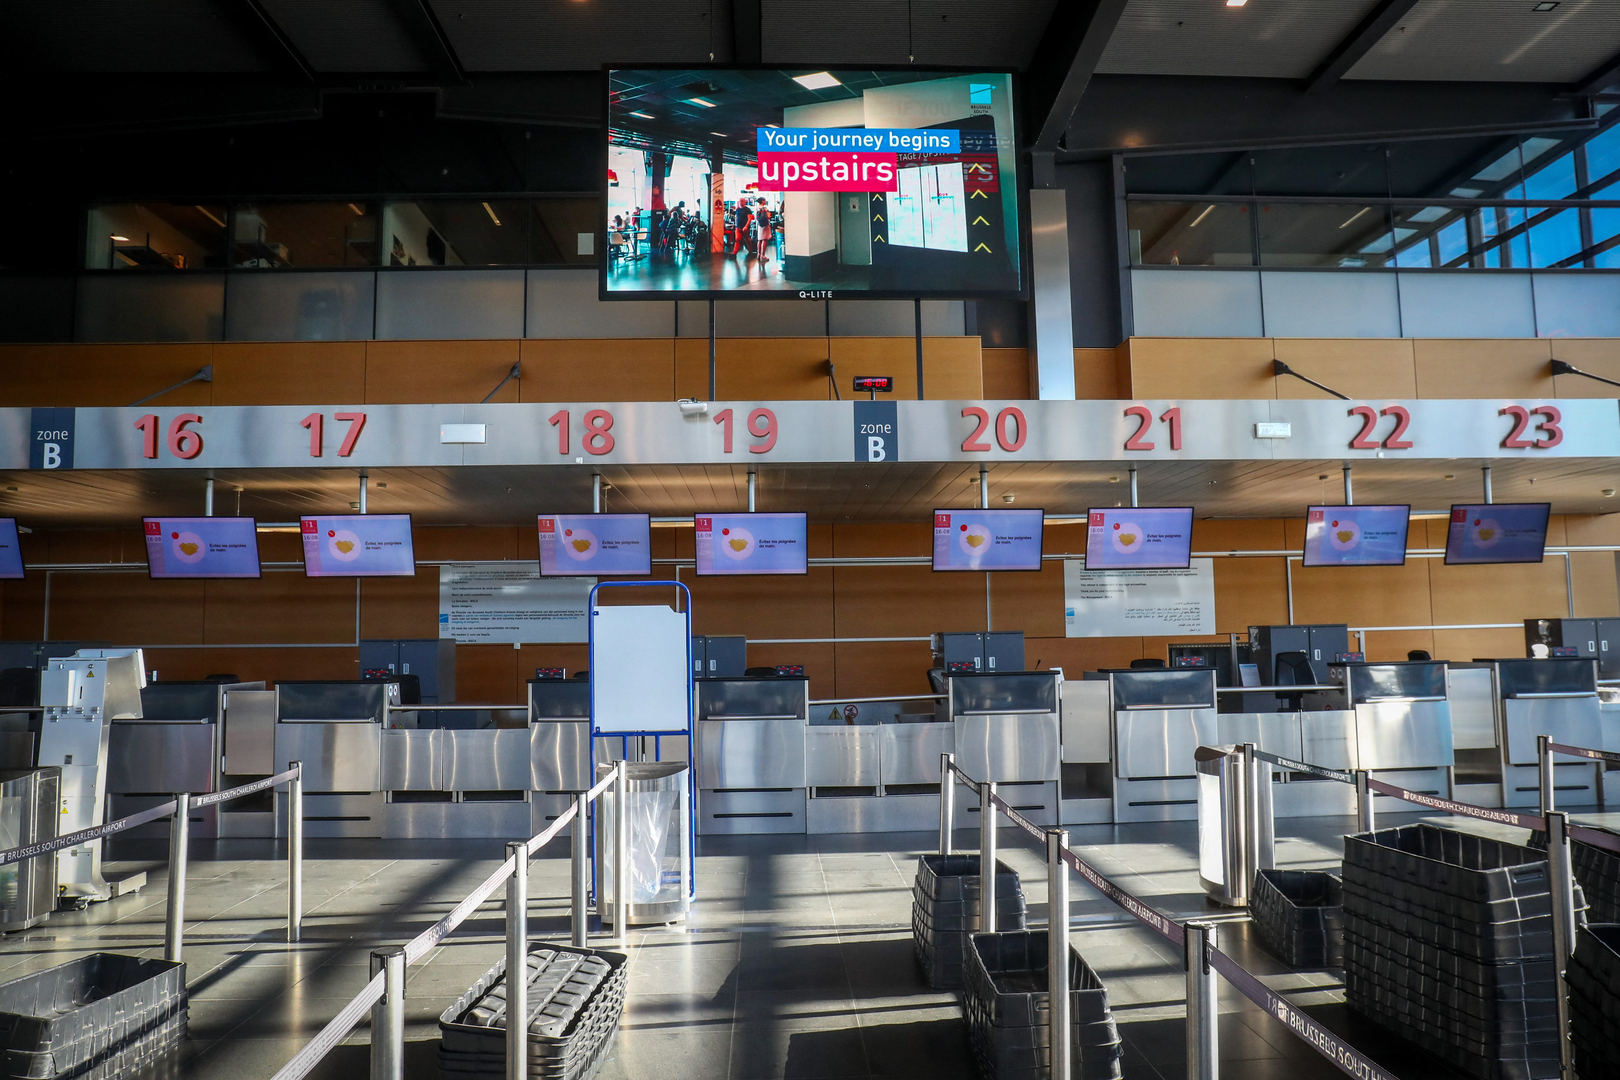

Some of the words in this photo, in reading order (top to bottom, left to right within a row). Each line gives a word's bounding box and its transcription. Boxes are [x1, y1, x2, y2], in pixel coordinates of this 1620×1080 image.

[765, 130, 807, 147] Your
[812, 130, 884, 151] journey
[889, 131, 950, 151] begins
[762, 154, 894, 188] upstairs
[799, 290, 832, 298] Q-LITE
[864, 378, 888, 388] 16:08
[36, 429, 68, 440] zone
[134, 413, 204, 460] 16
[300, 412, 367, 458] 17
[548, 409, 615, 455] 18
[712, 408, 778, 454] 19
[860, 422, 892, 434] zone
[961, 406, 1028, 452] 20
[1123, 406, 1182, 450] 21
[1348, 406, 1414, 448] 22
[1499, 406, 1564, 448] 23
[43, 442, 62, 468] B
[868, 436, 886, 462] B
[203, 794, 221, 804] BRUSSELS
[221, 790, 236, 800] SOUTH
[236, 784, 258, 796] CHARLEROI
[258, 779, 272, 789] AIRPORT
[7, 844, 40, 861] BRUSSELS
[41, 839, 65, 852] SOUTH
[66, 828, 100, 845] CHARLEROI
[101, 820, 126, 834] AIRPORT
[1097, 876, 1112, 896] SOUTH
[1138, 906, 1162, 929] AIRPORT
[1290, 1011, 1336, 1058] BRUSSELS
